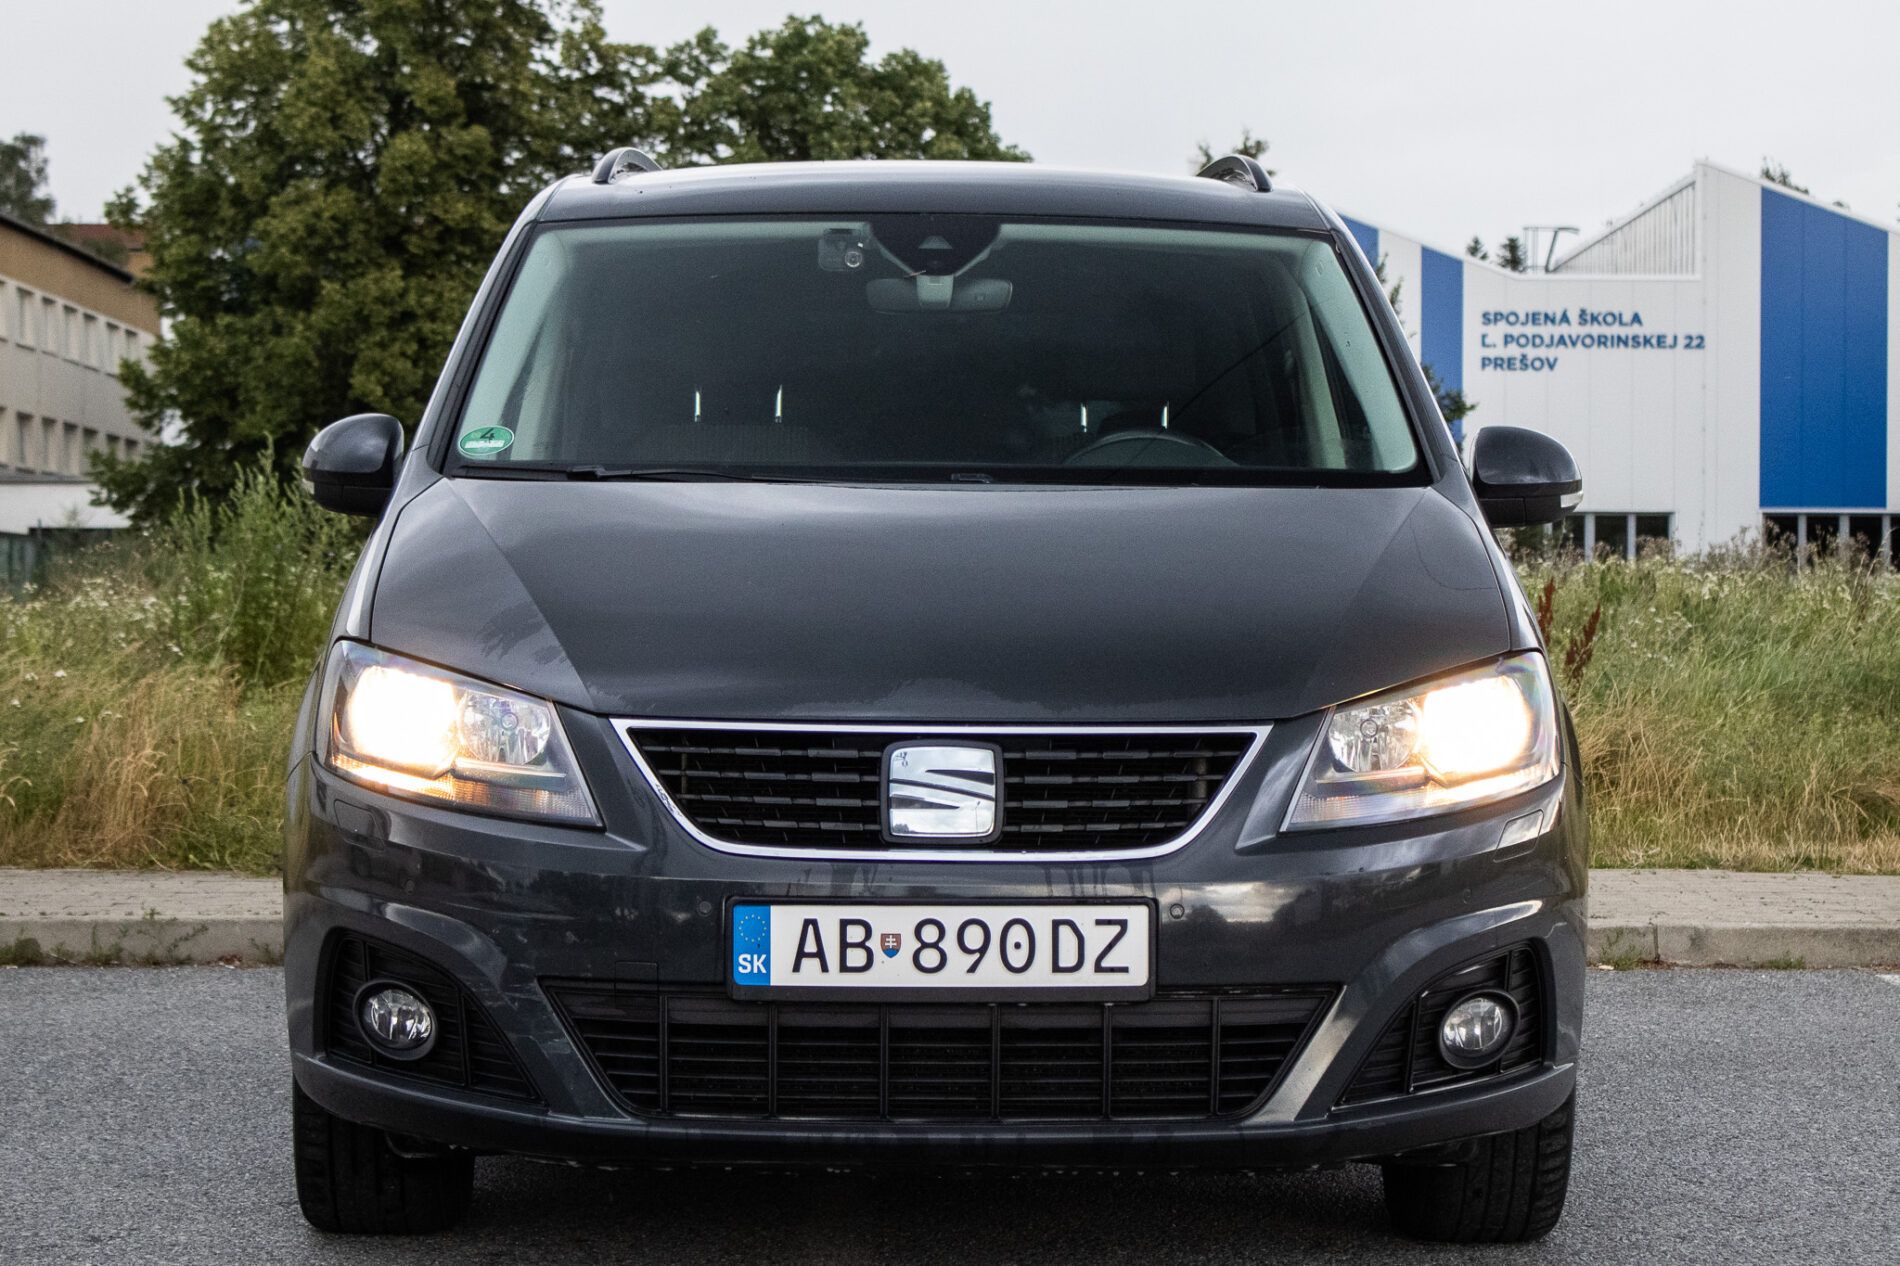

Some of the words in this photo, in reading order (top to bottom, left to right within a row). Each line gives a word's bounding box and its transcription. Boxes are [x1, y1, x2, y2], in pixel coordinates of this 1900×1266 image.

[1481, 309, 1571, 327] SPOJENÁ
[1578, 308, 1643, 327] ŠKOLA
[1504, 333, 1678, 349] PODJAVORINSKEJ
[1684, 334, 1705, 350] 22
[1481, 353, 1558, 371] PREŠOV
[480, 428, 495, 443] 4
[792, 918, 874, 974] AB
[738, 954, 767, 974] SK
